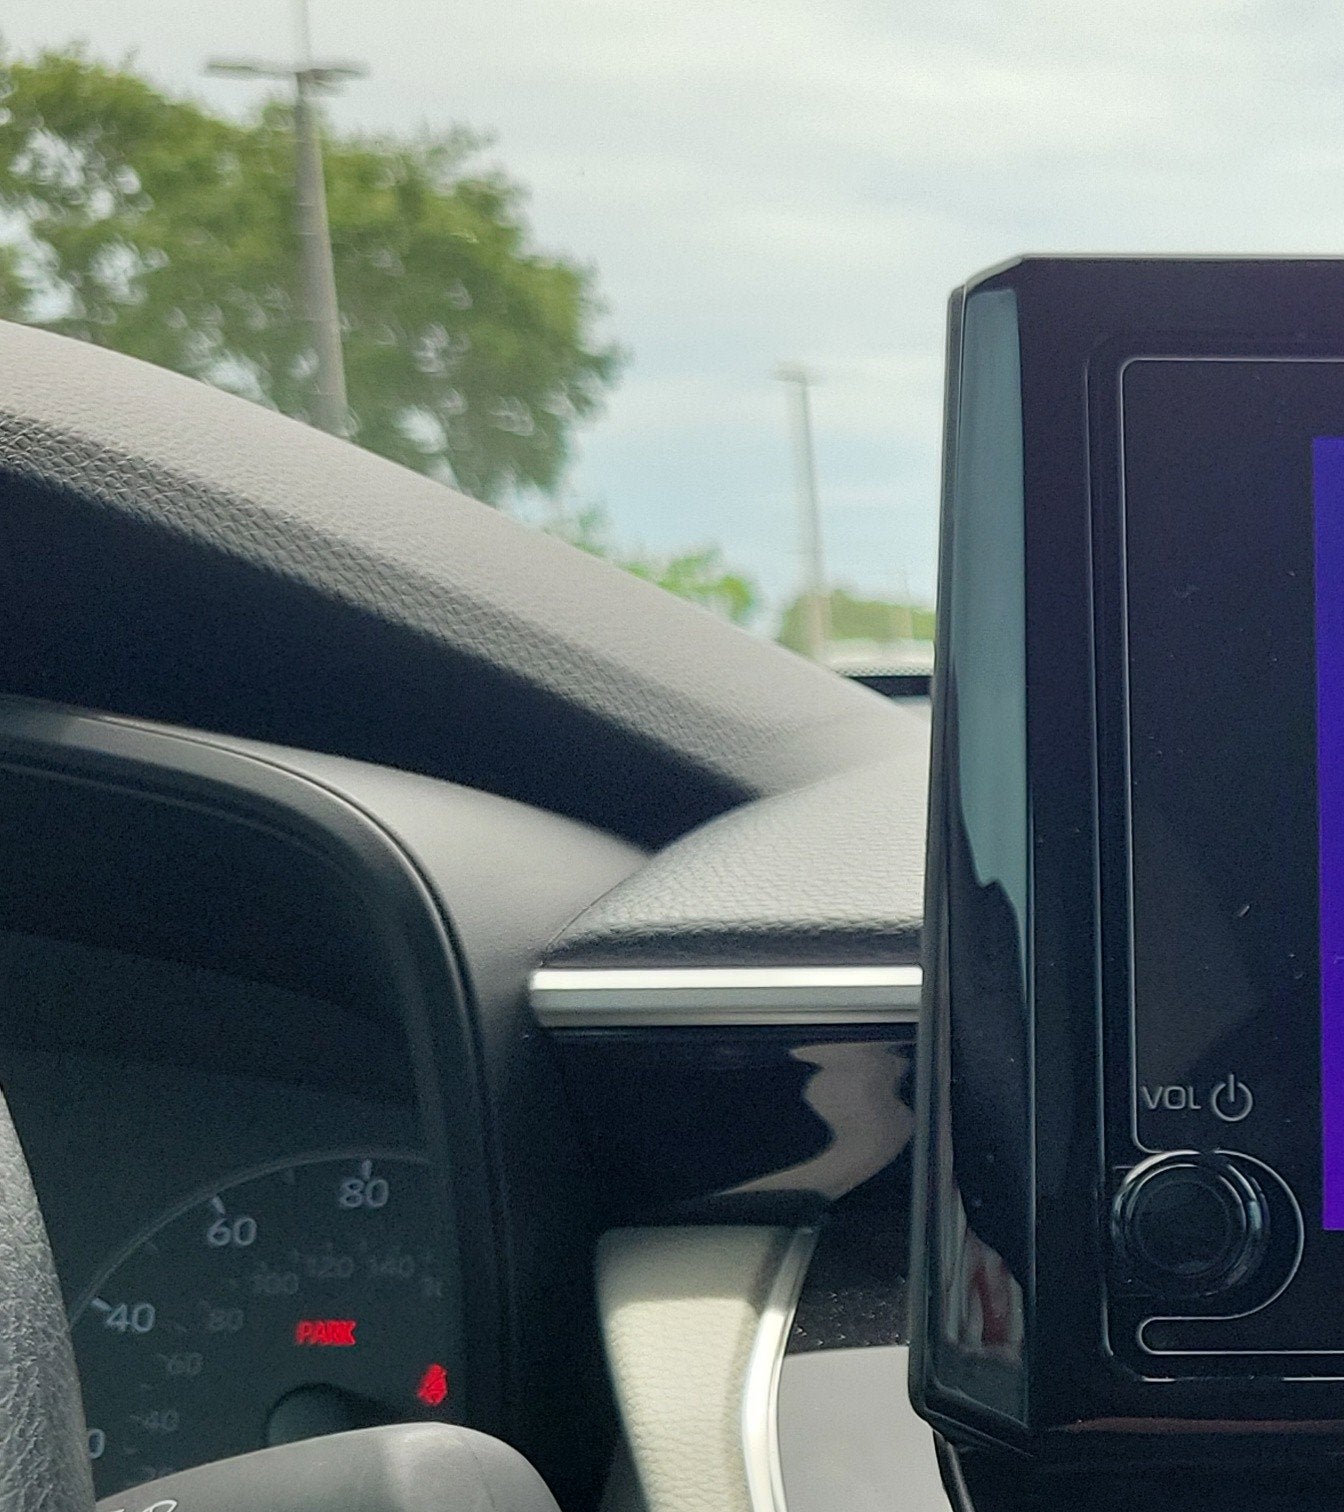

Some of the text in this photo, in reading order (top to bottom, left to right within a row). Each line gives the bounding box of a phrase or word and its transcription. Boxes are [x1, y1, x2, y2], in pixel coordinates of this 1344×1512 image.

[1141, 1086, 1201, 1110] VOL
[339, 1179, 389, 1208] 80
[207, 1217, 257, 1246] 60
[104, 1302, 156, 1334] 40
[295, 1318, 358, 1346] PARK
